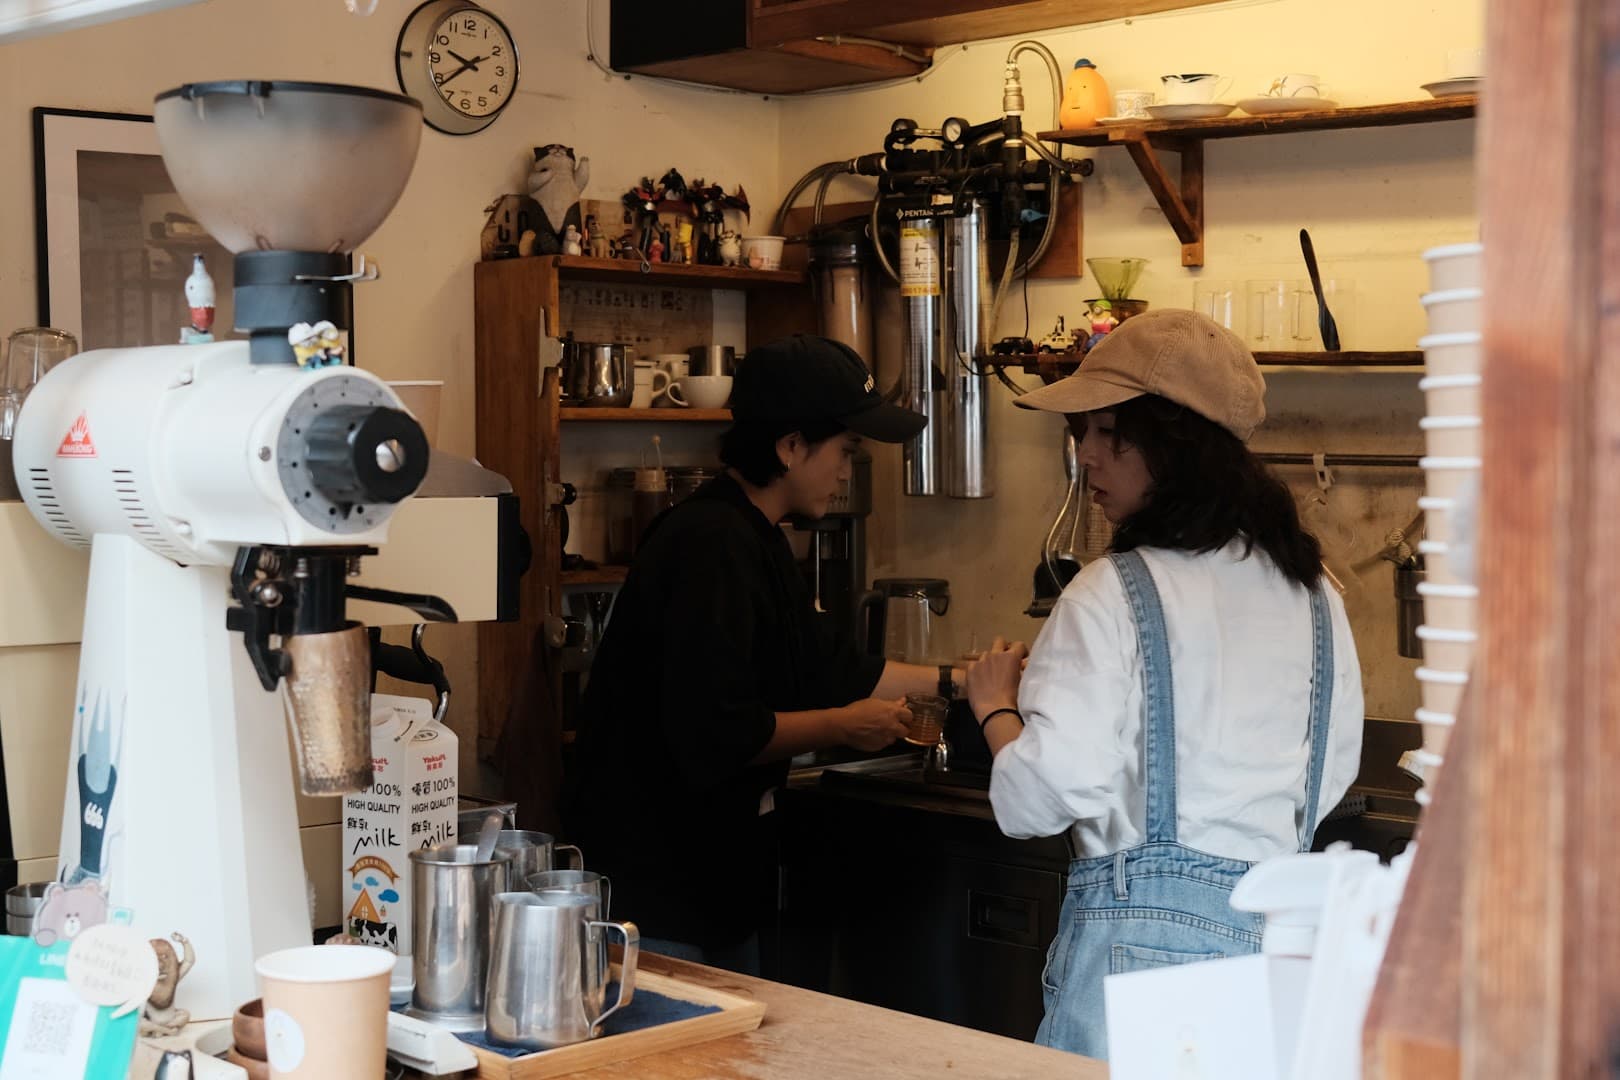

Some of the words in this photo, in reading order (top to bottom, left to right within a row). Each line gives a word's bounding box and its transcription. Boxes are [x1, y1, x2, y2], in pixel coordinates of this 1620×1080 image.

[449, 21, 458, 33] 11
[464, 19, 477, 31] 12
[435, 34, 449, 46] 10
[491, 45, 501, 57] 2
[430, 52, 441, 63] 9
[495, 66, 505, 77] 3
[434, 72, 444, 87] 8
[445, 89, 455, 101] 7
[488, 84, 499, 94] 4
[460, 98, 471, 110] 6
[477, 96, 488, 107] 5
[347, 799, 366, 810] HIGH
[367, 801, 400, 815] QUALITY
[411, 802, 429, 814] HIGH
[430, 796, 455, 811] QUALITY
